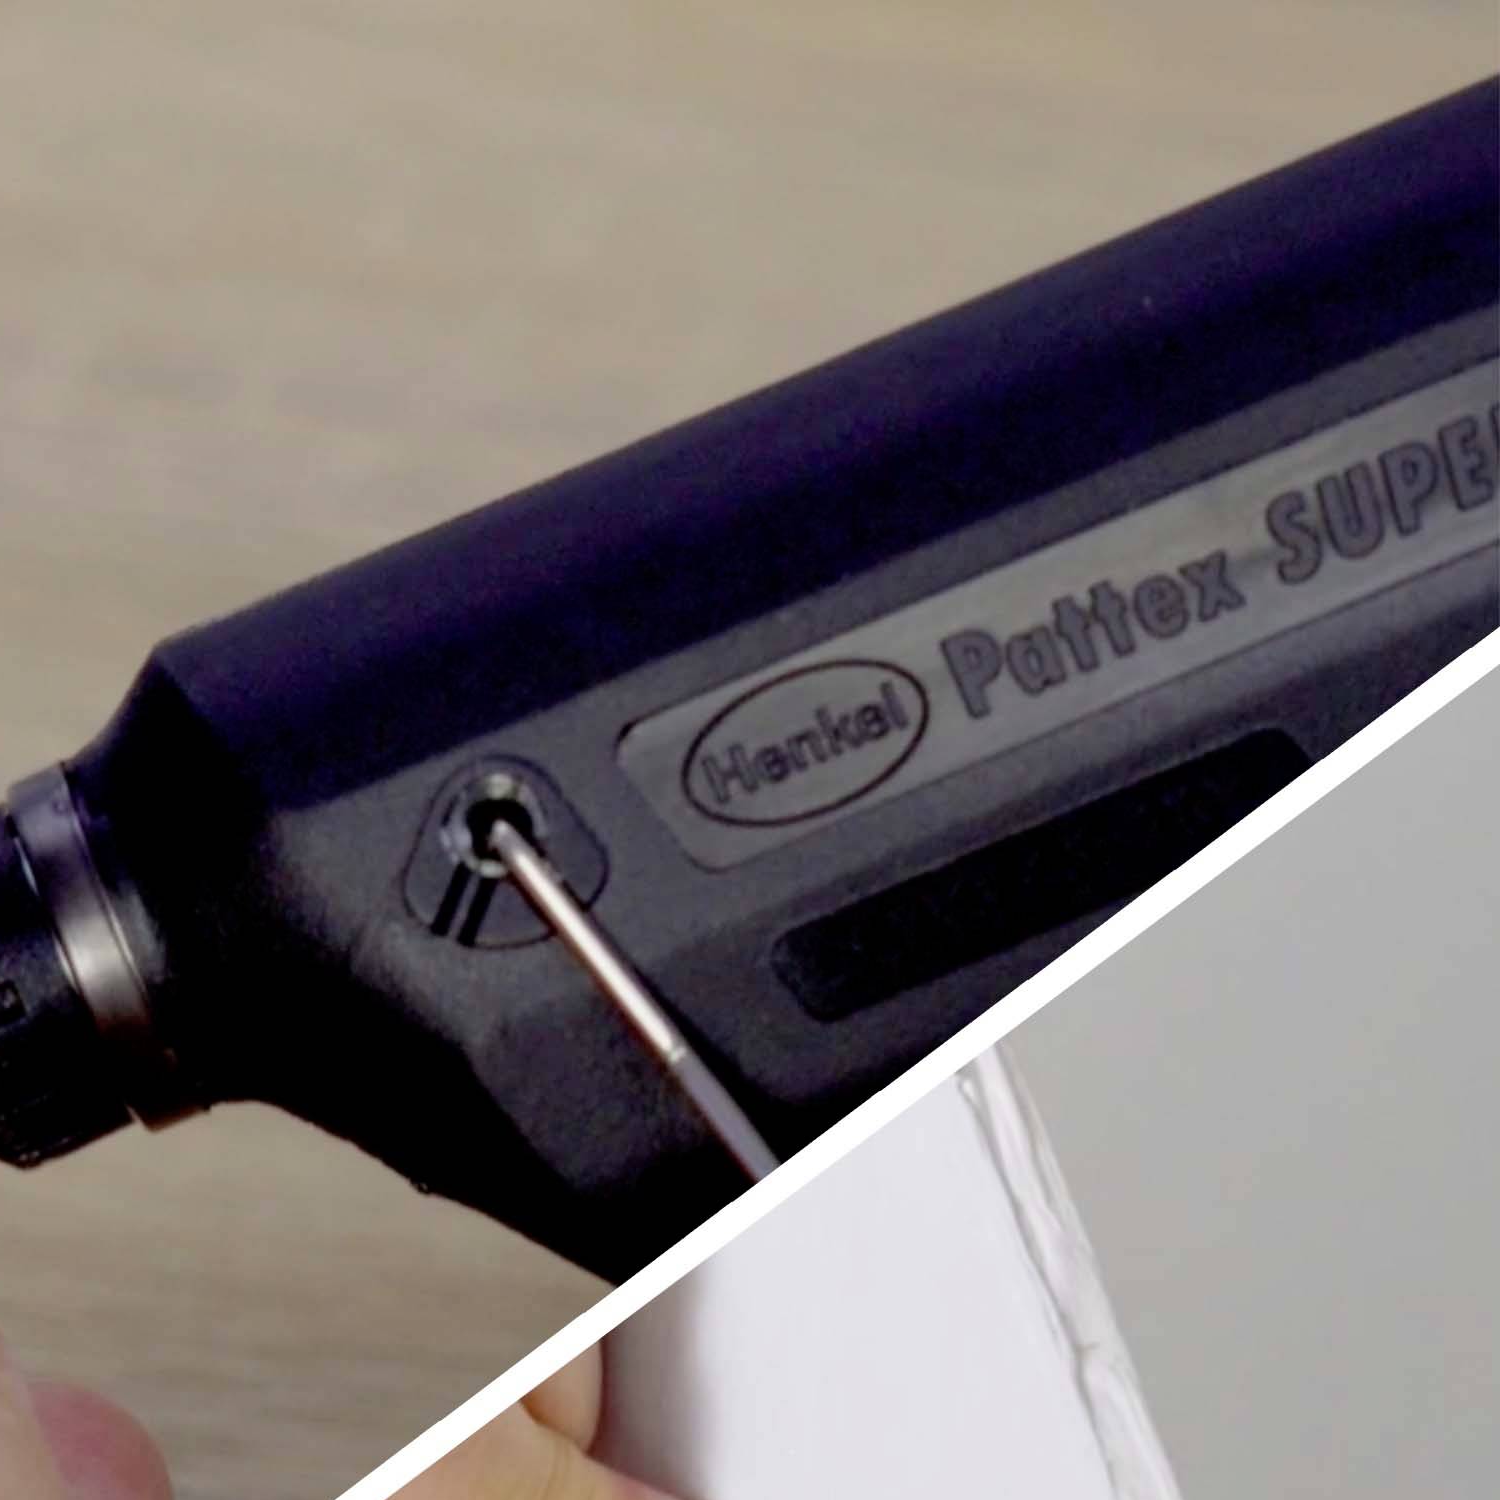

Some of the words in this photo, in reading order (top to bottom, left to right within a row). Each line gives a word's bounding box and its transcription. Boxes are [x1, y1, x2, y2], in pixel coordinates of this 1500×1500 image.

[700, 681, 910, 802] Henkel
[938, 549, 1246, 719] Pattex
[1265, 402, 1500, 586] SUPE
